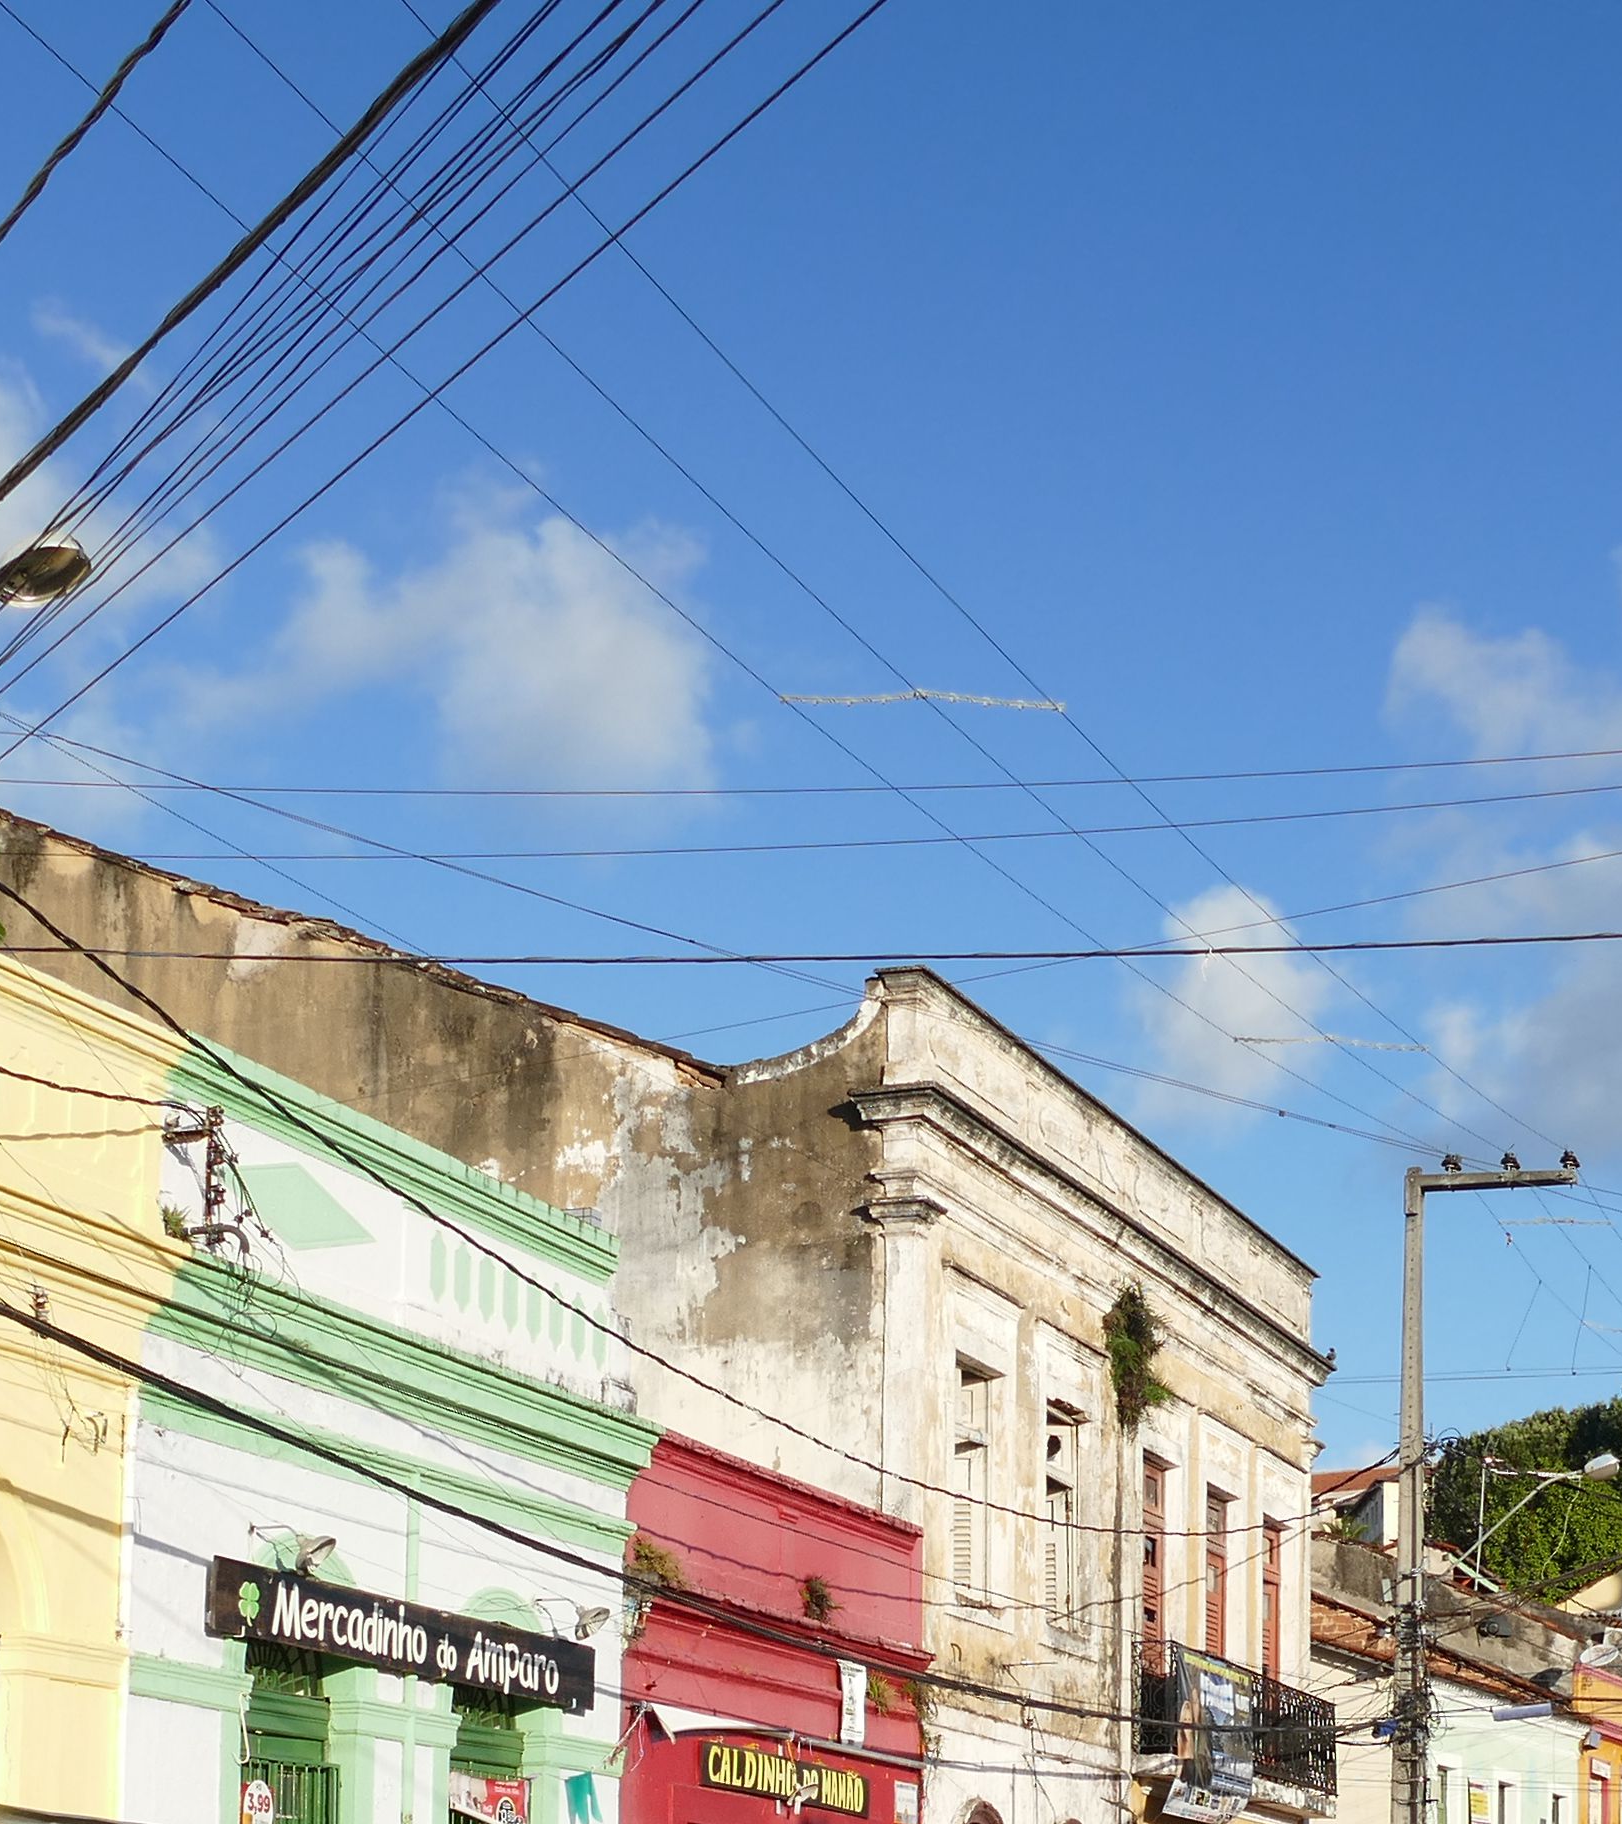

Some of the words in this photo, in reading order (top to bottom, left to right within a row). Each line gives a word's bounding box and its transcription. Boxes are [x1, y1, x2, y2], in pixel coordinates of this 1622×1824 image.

[272, 1579, 427, 1665] Mercadinho
[436, 1632, 458, 1672] do
[465, 1630, 561, 1695] Amparo
[247, 1792, 271, 1815] 3,99
